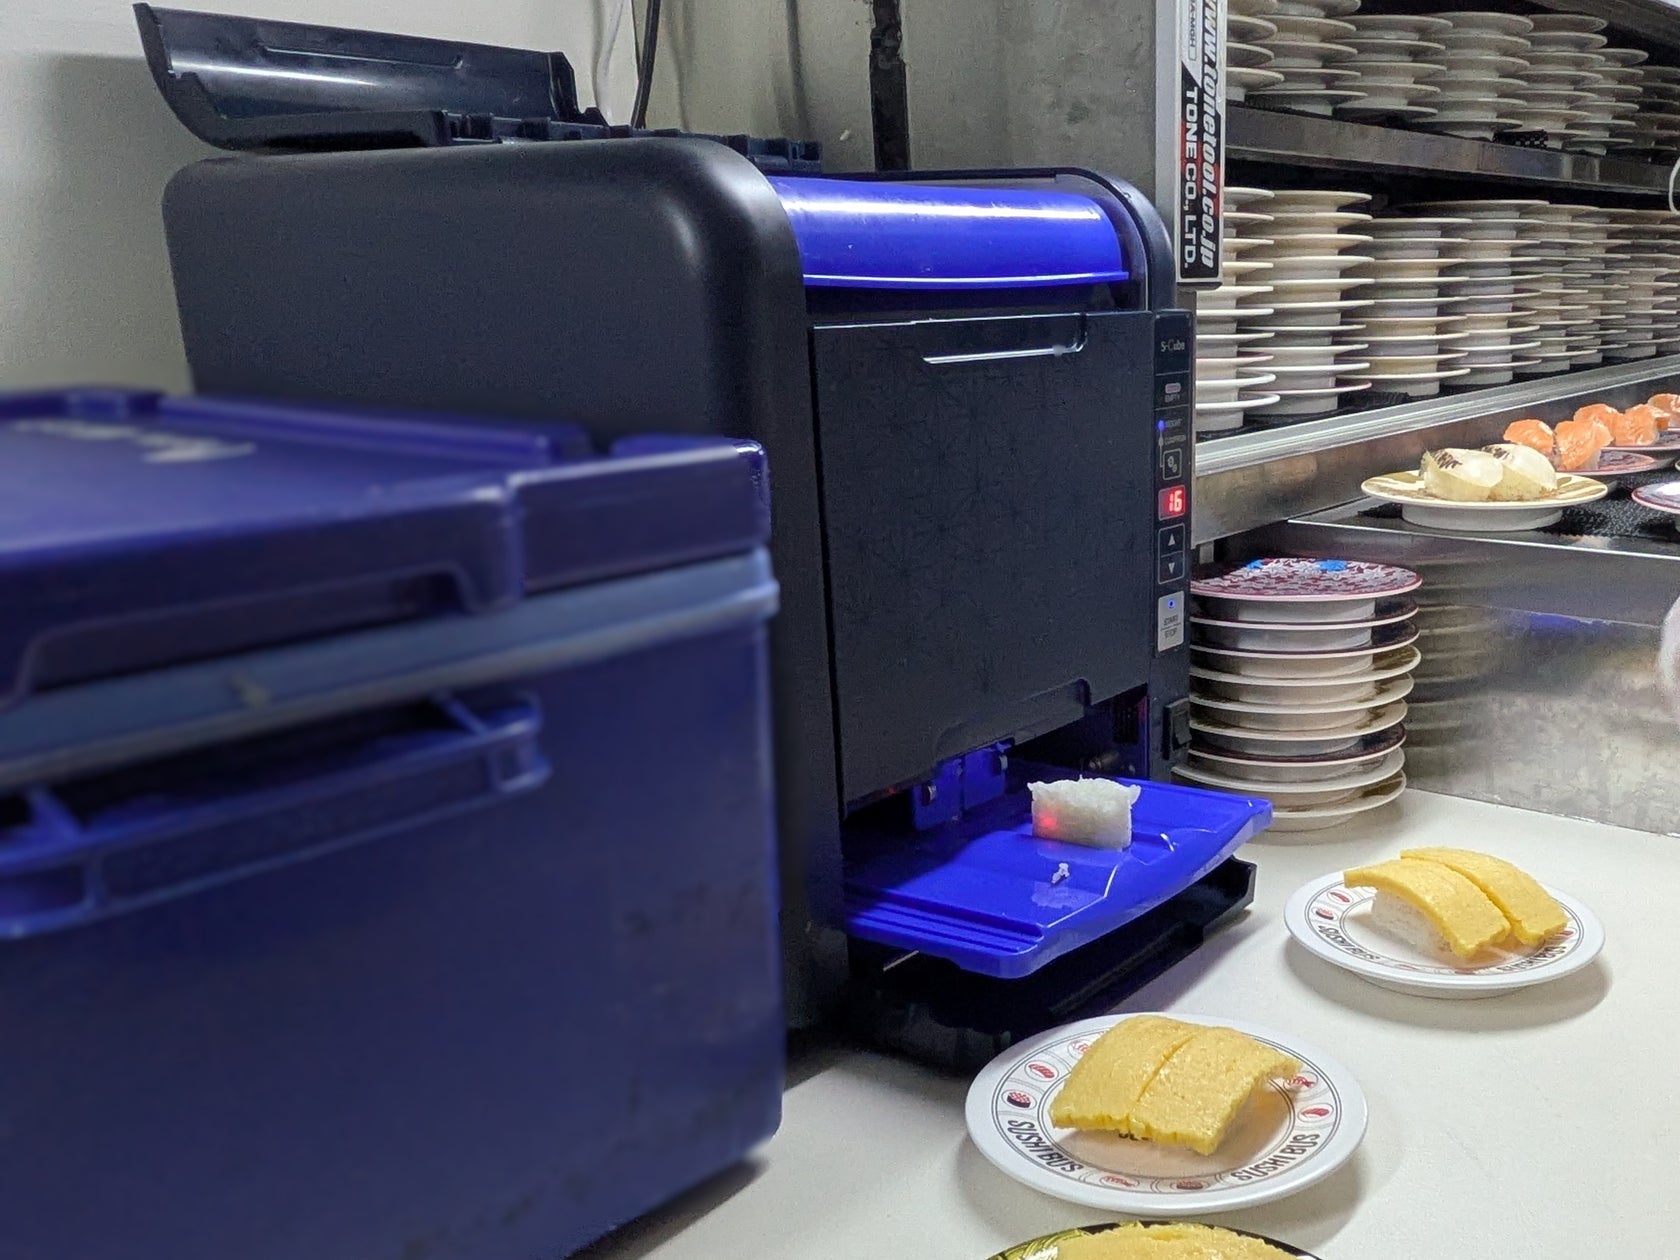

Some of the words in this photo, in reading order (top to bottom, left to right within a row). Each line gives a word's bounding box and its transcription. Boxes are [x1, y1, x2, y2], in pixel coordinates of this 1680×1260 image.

[1185, 86, 1198, 159] TONE
[1183, 214, 1197, 269] LTD.
[1169, 489, 1183, 512] 16
[1007, 1119, 1054, 1153] SUSHI
[1038, 1152, 1084, 1173] BUS
[1230, 1155, 1296, 1181] SUSHI
[1280, 1133, 1320, 1156] BUS
